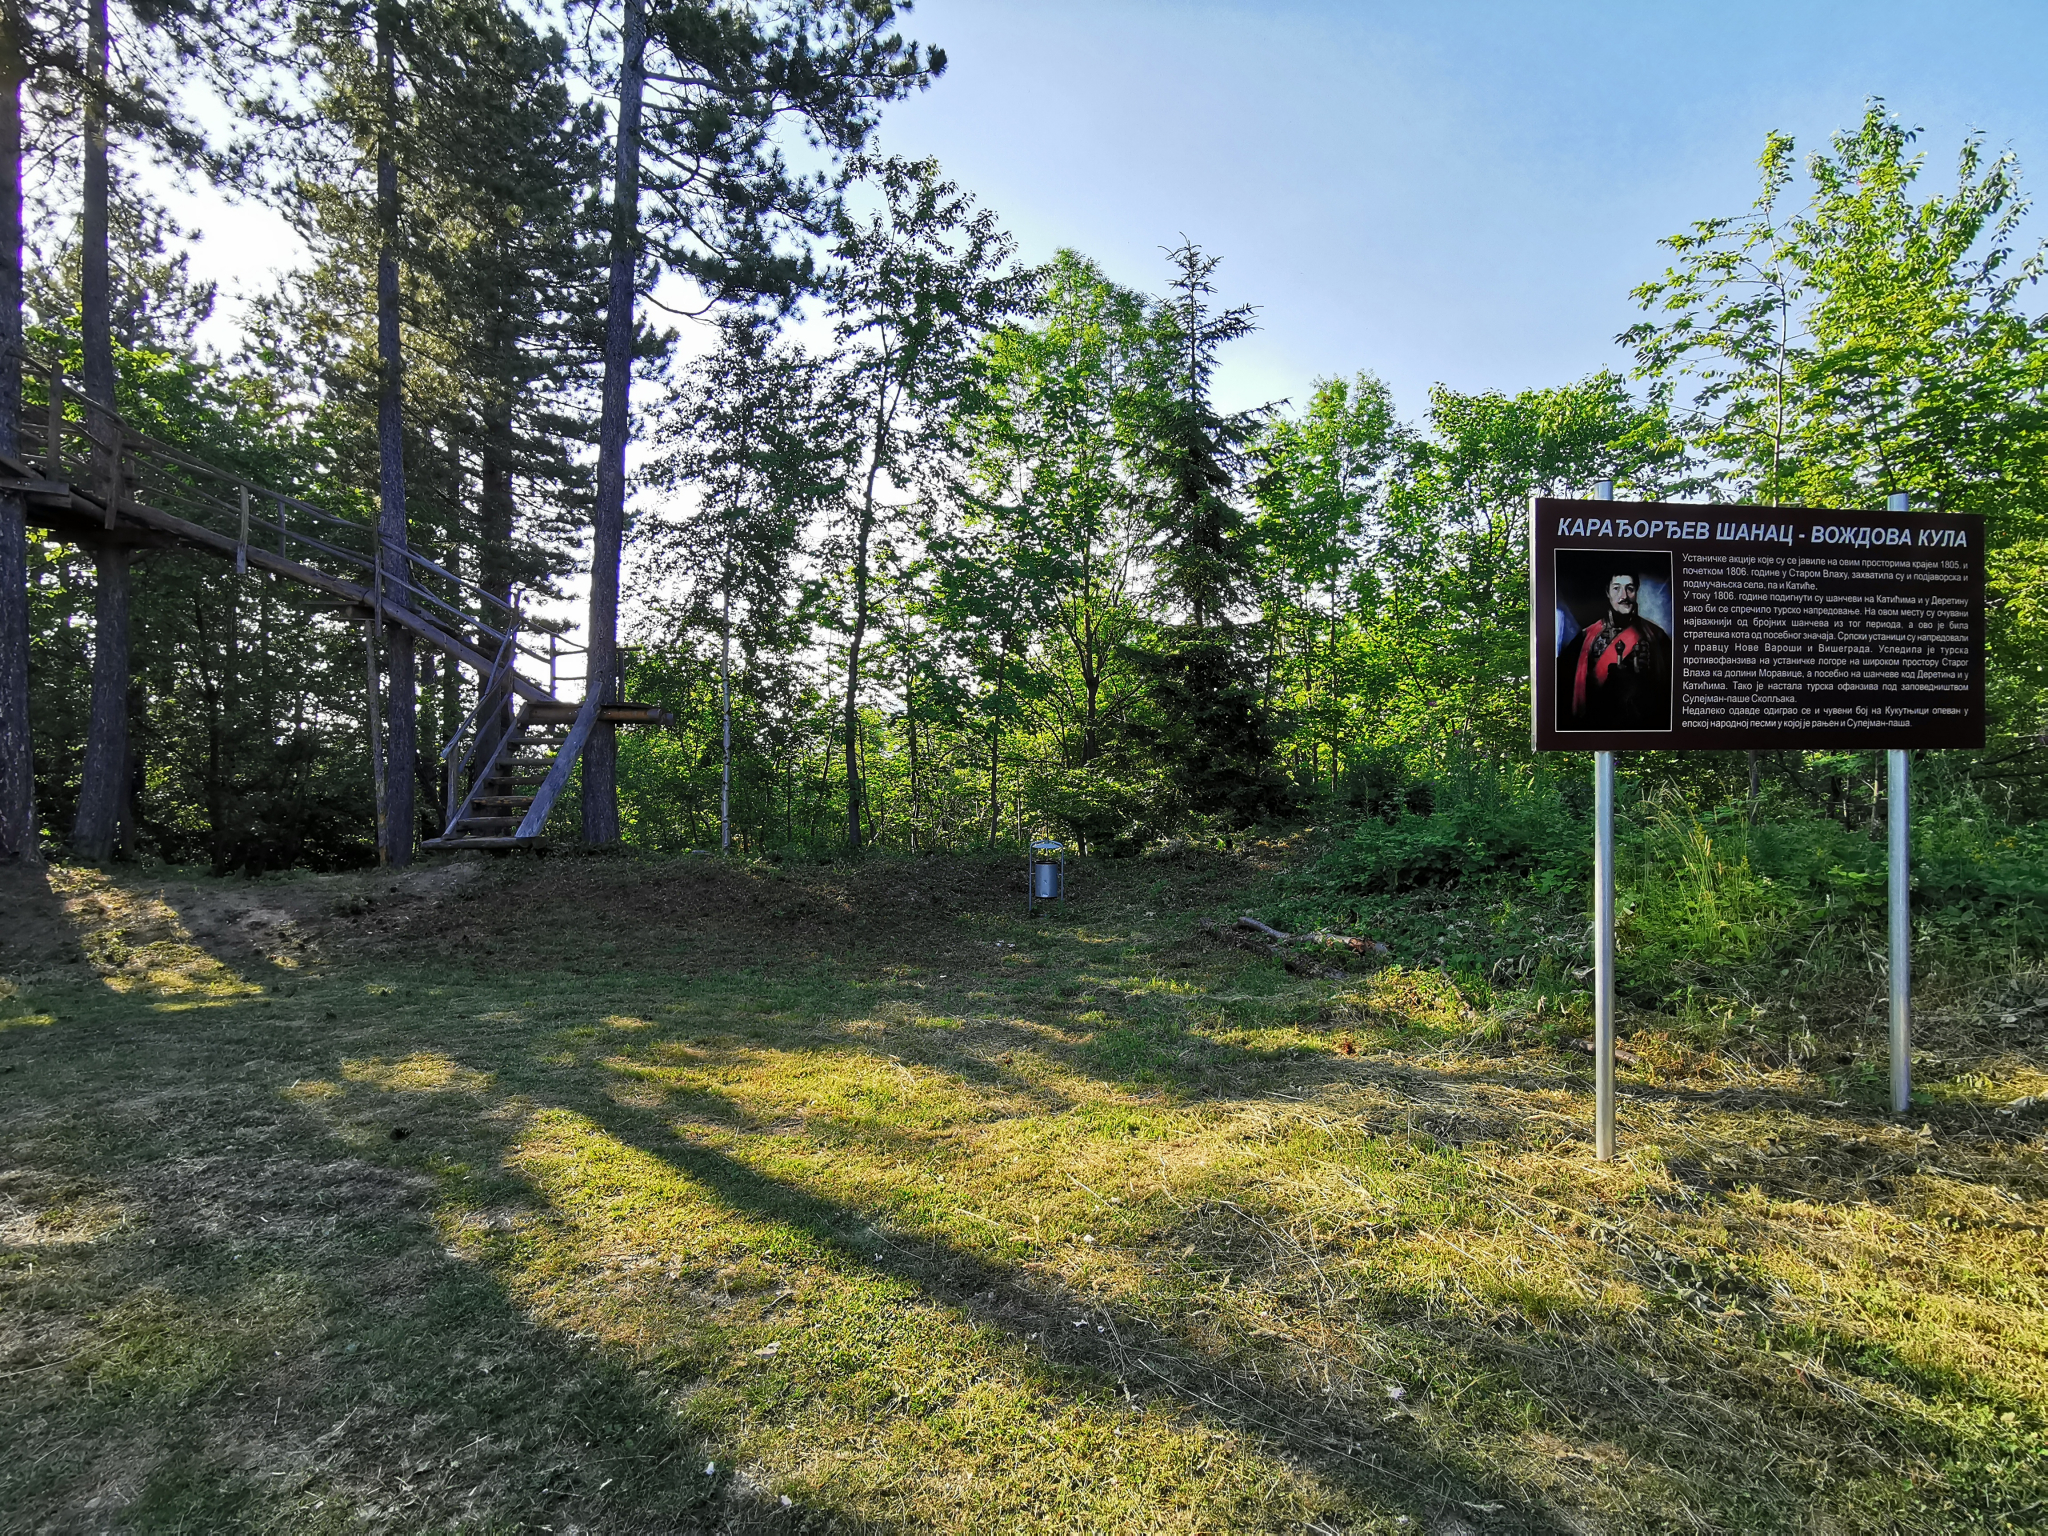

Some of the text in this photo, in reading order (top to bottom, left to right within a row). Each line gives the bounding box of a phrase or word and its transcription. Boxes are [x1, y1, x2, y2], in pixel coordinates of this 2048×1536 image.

[1557, 517, 1710, 540] КАРАЂОРЂЕВ
[1716, 522, 1794, 547] ШАНАЦ
[1810, 525, 1912, 549] ВОЖДОВА
[1918, 529, 1968, 548] КУЛА
[1681, 552, 1728, 563] Устаничке
[1728, 554, 1756, 566] акције
[1757, 556, 1775, 566] које
[1775, 557, 1786, 566] су
[1786, 557, 1797, 565] се
[1797, 556, 1826, 567] јавиле
[1827, 558, 1838, 566] на
[1861, 559, 1911, 569] просторима
[1911, 561, 1939, 570] крајем
[1682, 567, 1724, 576] почетком
[1750, 569, 1780, 578] године
[1788, 568, 1821, 580] Старом
[1851, 571, 1894, 580] захватила
[1895, 573, 1905, 582] су
[1767, 582, 1778, 590] па
[1691, 592, 1711, 602] току
[1738, 593, 1768, 602] године
[1769, 593, 1813, 604] подигнути
[1814, 595, 1824, 604] су
[1825, 595, 1863, 603] шанчеви
[1876, 594, 1916, 604] Катићима
[1930, 595, 1969, 607] Деретину
[1683, 605, 1704, 613] како
[1704, 603, 1717, 613] би
[1718, 605, 1729, 613] се
[1730, 605, 1772, 615] спречило
[1773, 606, 1802, 616] турско
[1864, 606, 1876, 616] На
[1877, 608, 1899, 616] овом
[1900, 609, 1925, 619] месту
[1925, 610, 1936, 619] су
[1936, 610, 1969, 619] очувани
[1683, 616, 1732, 628] најважнији
[1736, 618, 1749, 627] од
[1752, 617, 1787, 629] бројних
[1791, 619, 1829, 628] шанчева
[1833, 620, 1844, 628] из
[1848, 620, 1861, 628] тог
[1917, 621, 1934, 629] ово
[1936, 622, 1945, 631] је
[1948, 620, 1969, 630] била
[1683, 631, 1730, 640] стратешка
[1730, 631, 1750, 639] кота
[1750, 631, 1763, 640] од
[1762, 630, 1802, 640] посебног
[1837, 631, 1868, 642] Српски
[1868, 633, 1906, 643] устаници
[1906, 634, 1917, 643] су
[1916, 634, 1969, 643] напредовали
[1694, 644, 1730, 654] правцу
[1734, 642, 1759, 652] Нове
[1764, 642, 1802, 653] Вароши
[1878, 644, 1922, 655] Уследила
[1926, 645, 1935, 656] је
[1940, 647, 1969, 656] турска
[1683, 655, 1969, 668] противофанзива на устаничке логоре на широком простору Старог
[1682, 667, 1711, 678] Влаха
[1712, 669, 1723, 677] ка
[1723, 670, 1757, 678] долини
[1814, 668, 1849, 678] посебно
[1850, 670, 1861, 678] на
[1862, 671, 1900, 679] шанчеве
[1900, 671, 1916, 679] код
[1916, 669, 1956, 680] Деретина
[1732, 680, 1753, 690] Тако
[1755, 680, 1764, 692] је
[1767, 682, 1803, 690] настала
[1806, 683, 1834, 693] турска
[1837, 682, 1879, 692] офанзива
[1881, 683, 1898, 692] под
[1900, 683, 1969, 692] заповедништвом
[1682, 693, 1750, 705] Сулејман-паше
[1682, 705, 1726, 716] Недалеко
[1728, 707, 1761, 716] одавде
[1763, 707, 1798, 716] одиграо
[1800, 707, 1812, 715] се
[1823, 707, 1853, 717] чувени
[1855, 705, 1868, 717] бој
[1871, 707, 1882, 715] на
[1931, 707, 1961, 715] опеван
[1681, 718, 1709, 730] епској
[1709, 718, 1749, 730] народној
[1749, 720, 1777, 728] песми
[1783, 718, 1803, 730] којој
[1802, 718, 1811, 729] је
[1811, 720, 1839, 729] рањен
